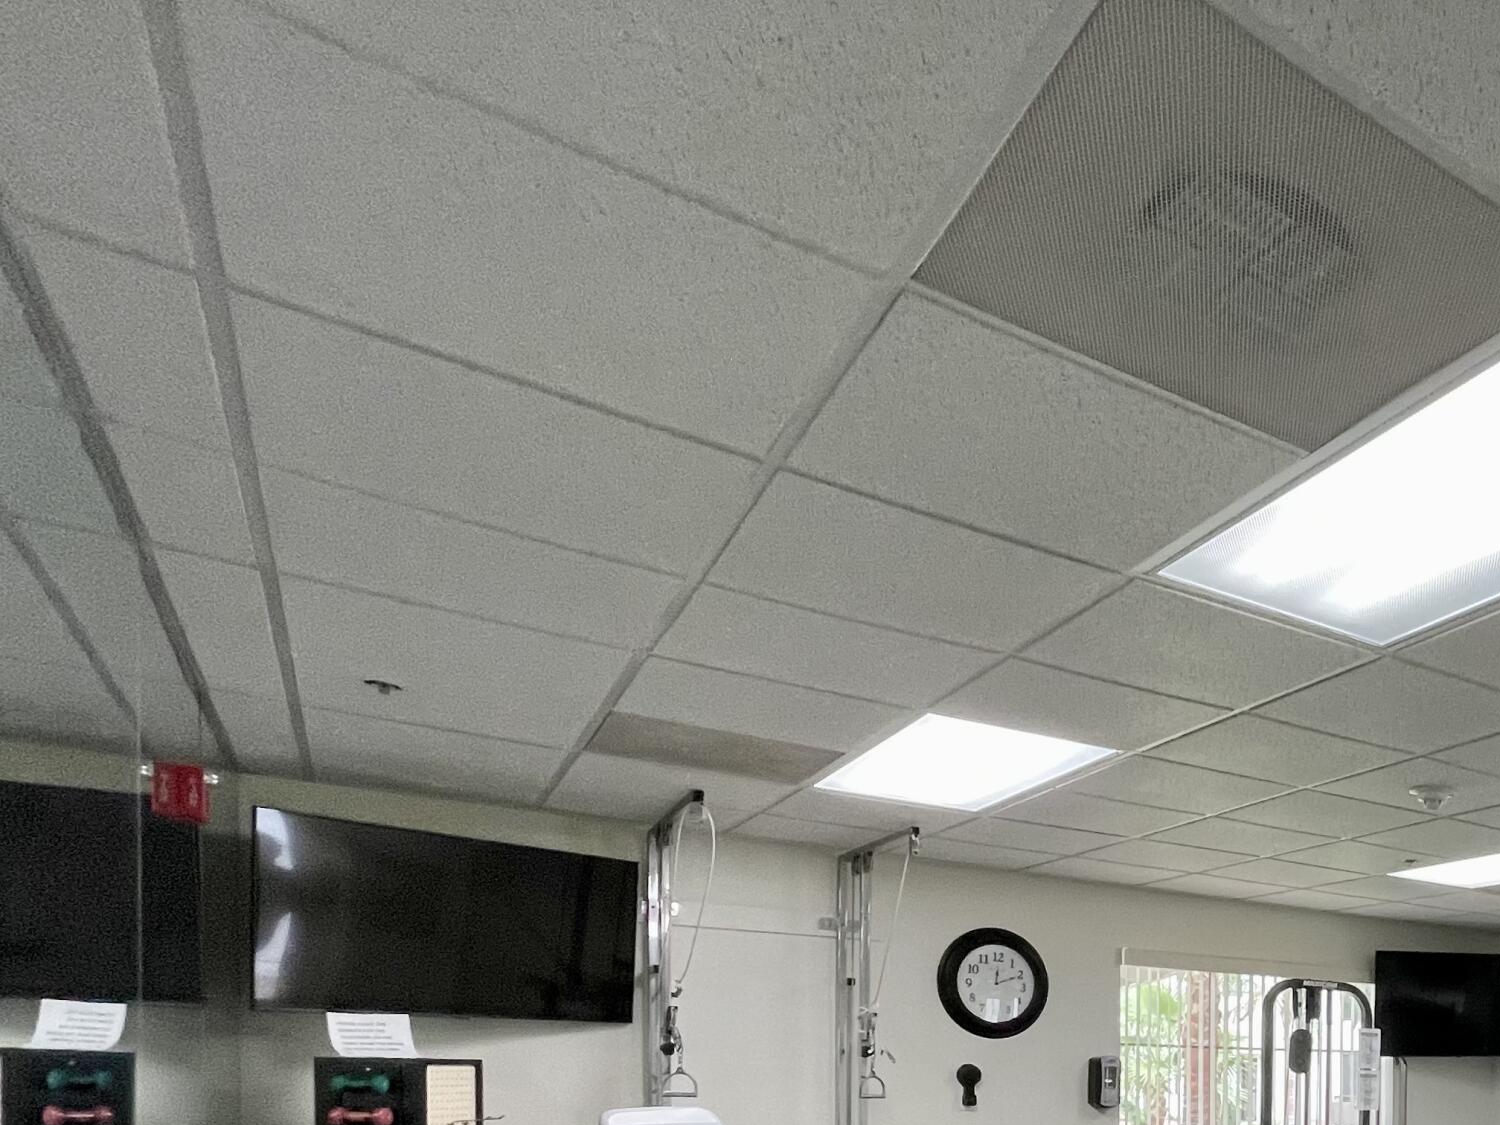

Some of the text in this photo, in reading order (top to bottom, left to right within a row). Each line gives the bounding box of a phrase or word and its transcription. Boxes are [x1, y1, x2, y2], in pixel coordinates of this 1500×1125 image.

[979, 954, 989, 964] 11
[993, 952, 1004, 962] 12
[968, 964, 979, 974] 10
